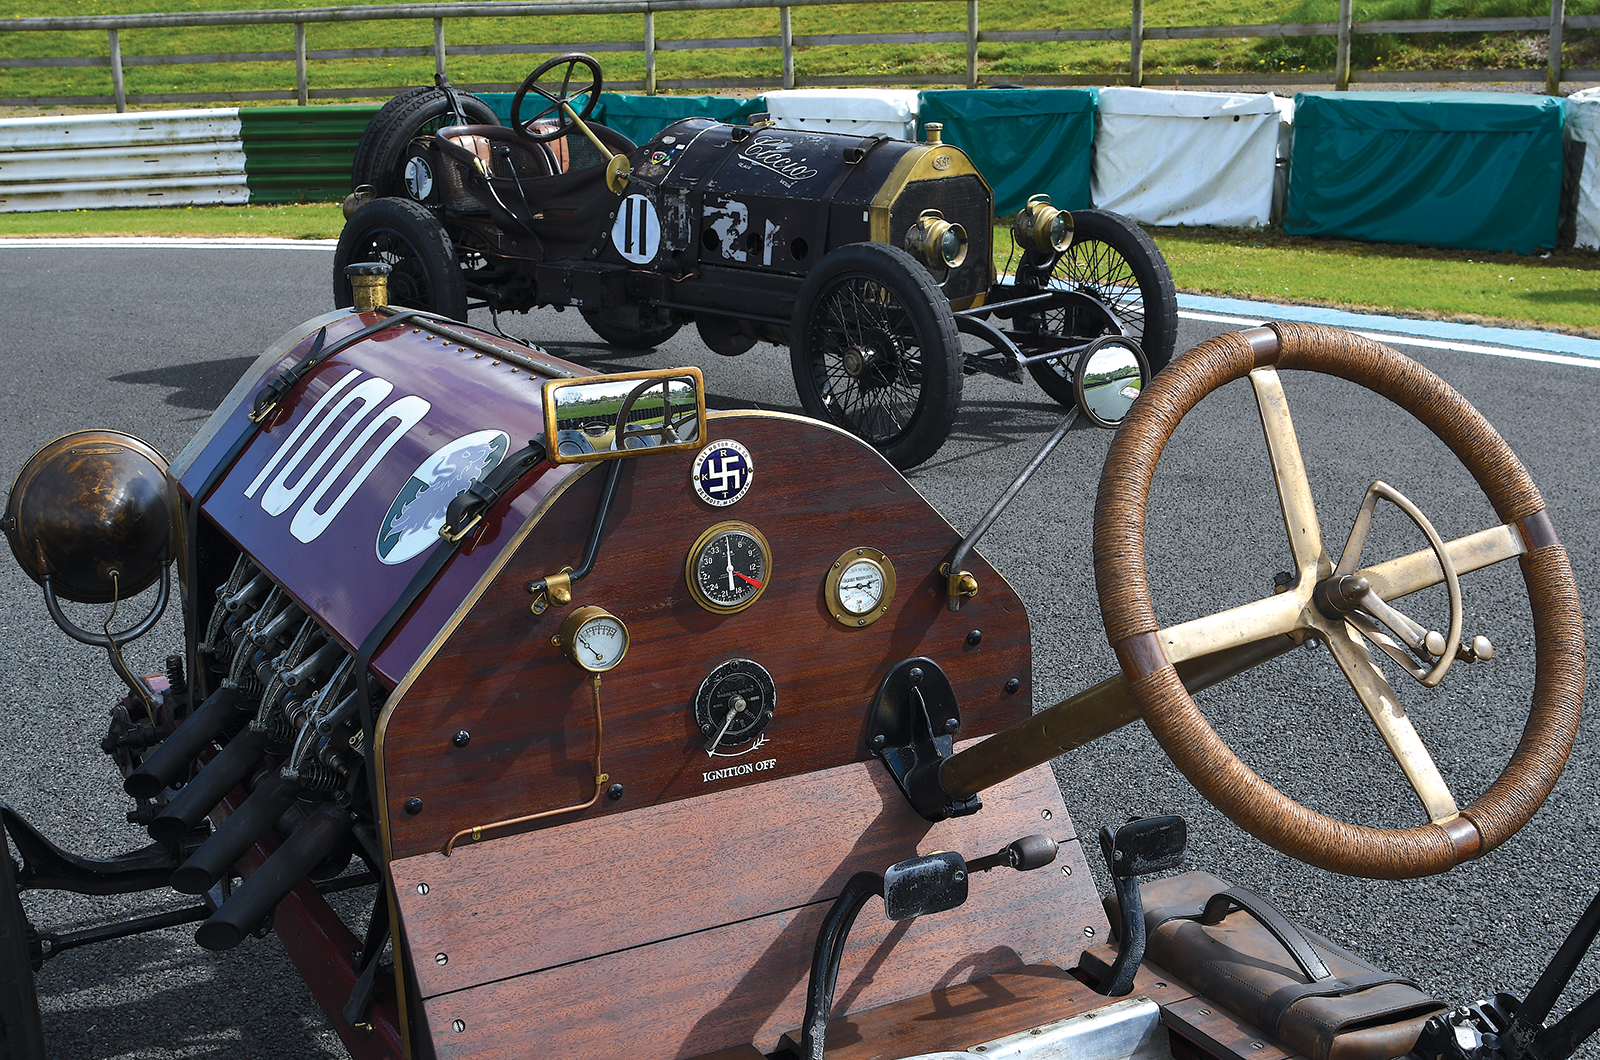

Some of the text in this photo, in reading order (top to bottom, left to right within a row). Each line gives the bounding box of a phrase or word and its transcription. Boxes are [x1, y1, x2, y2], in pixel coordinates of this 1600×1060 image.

[624, 197, 647, 257] 11
[243, 368, 432, 544] 100
[697, 451, 708, 467] KRIT
[708, 442, 729, 452] MOTOR
[730, 443, 742, 451] CAR
[719, 449, 727, 457] R
[701, 473, 709, 481] K
[721, 491, 729, 499] T
[710, 546, 720, 555] 33
[703, 557, 713, 566] 30
[749, 563, 757, 571] 12
[709, 582, 719, 591] 24
[735, 586, 743, 594] 18
[720, 589, 728, 598] 21
[701, 758, 777, 783] IGNITION OFF
